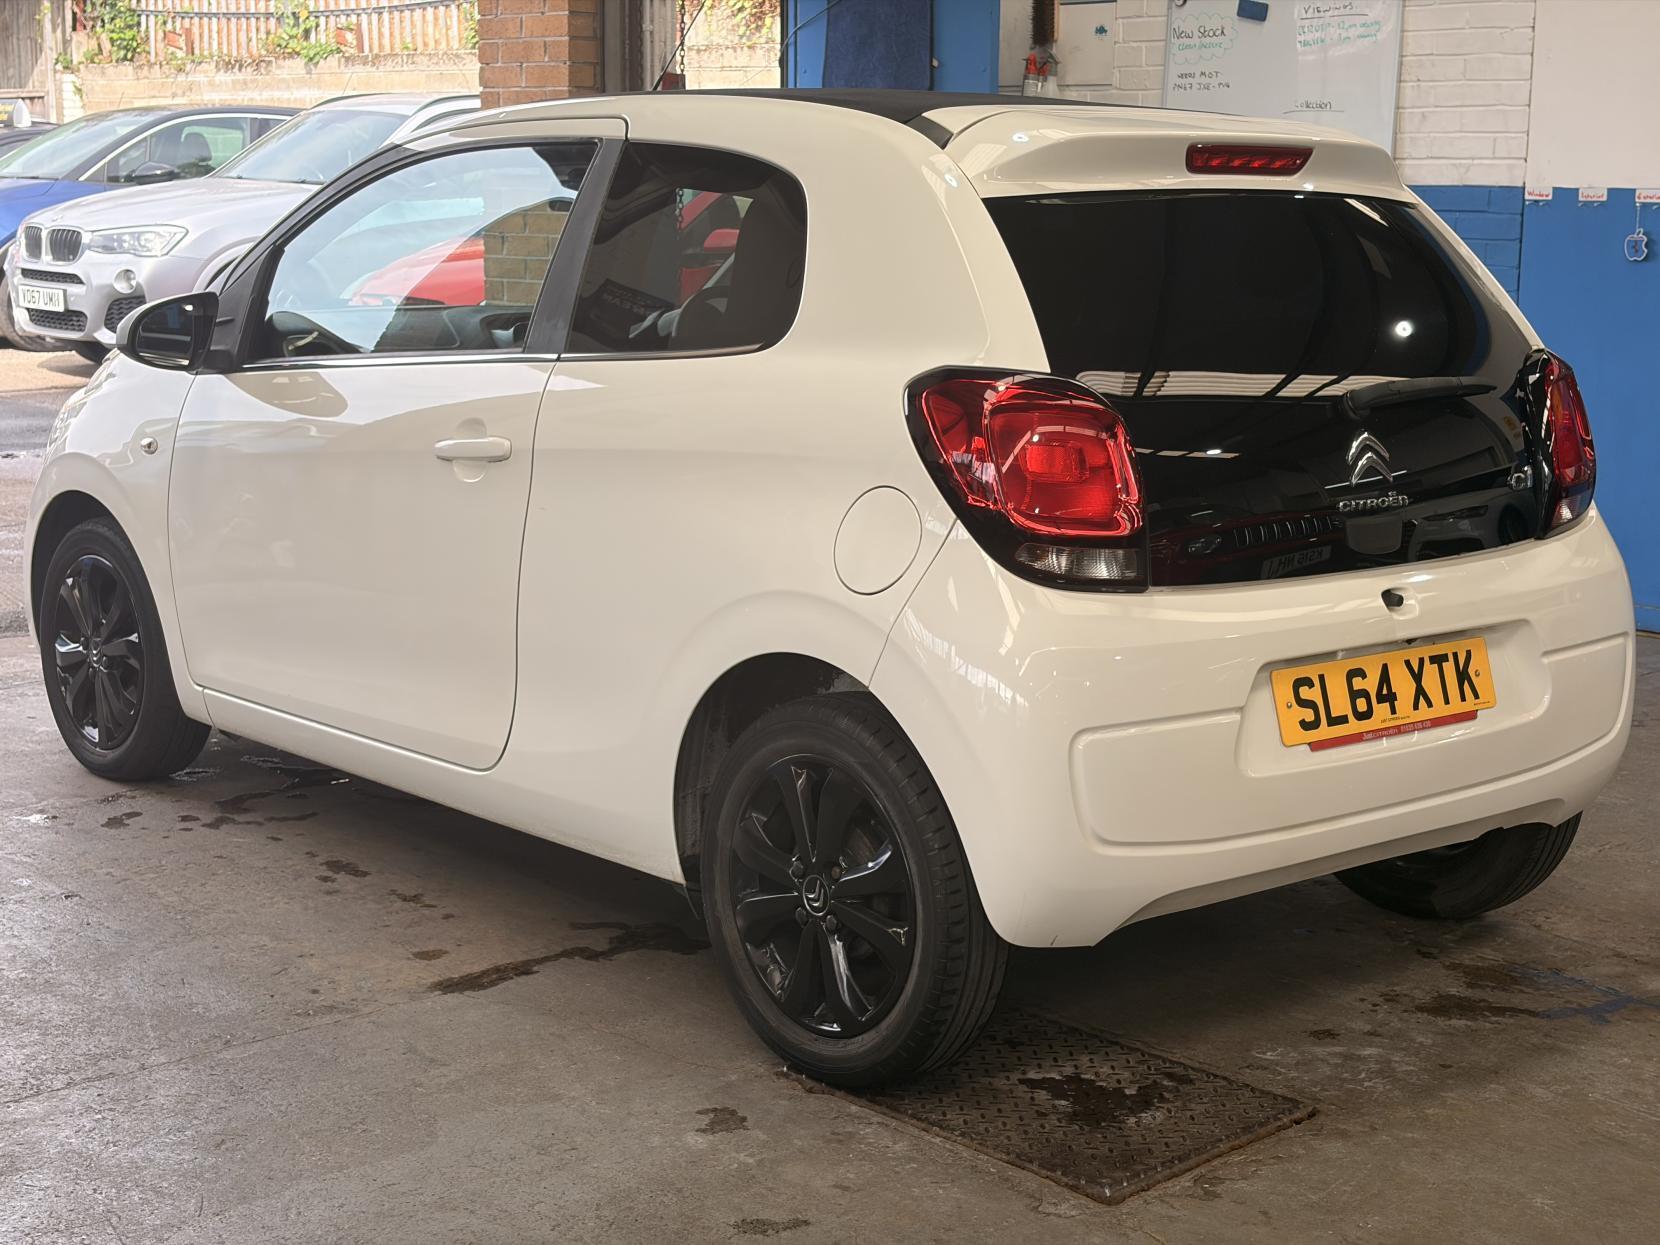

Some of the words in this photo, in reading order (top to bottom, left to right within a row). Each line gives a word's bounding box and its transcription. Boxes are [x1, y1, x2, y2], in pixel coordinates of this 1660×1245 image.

[1172, 24, 1194, 40] New
[1198, 24, 1226, 39] Stock
[1292, 662, 1398, 732] SL64
[1404, 649, 1480, 711] XTK
